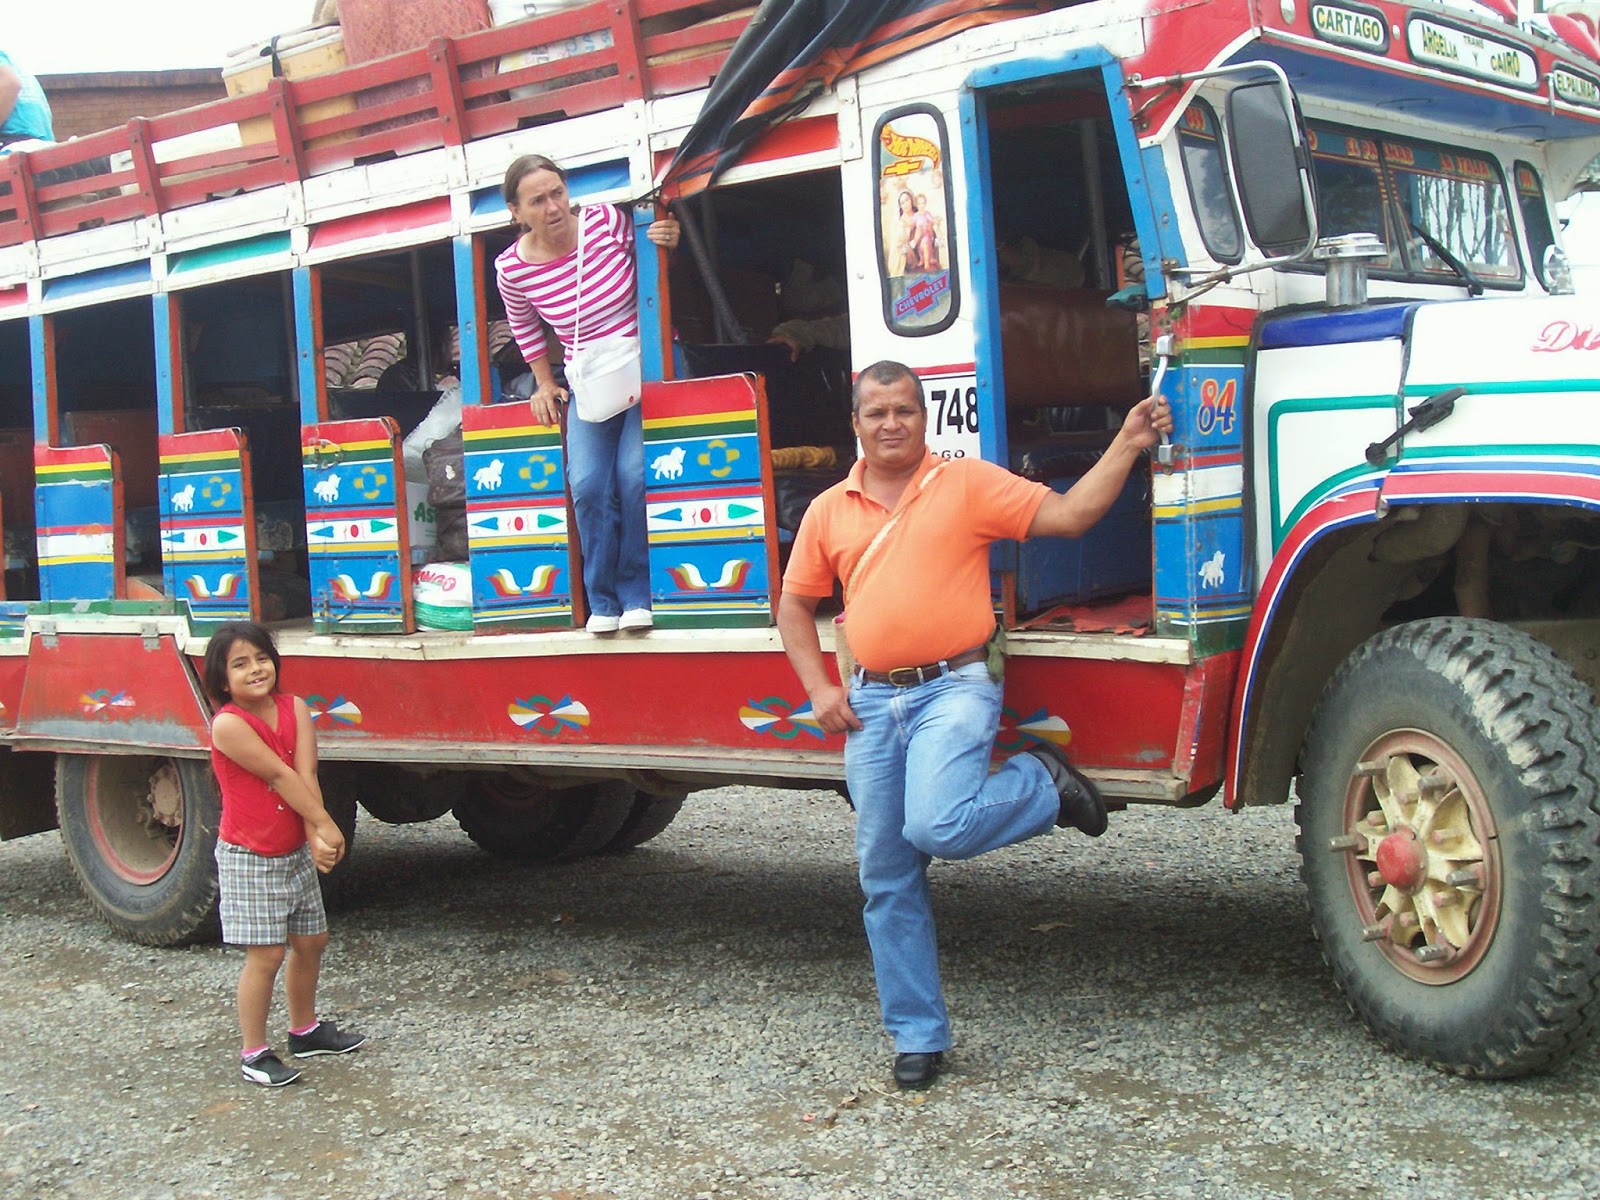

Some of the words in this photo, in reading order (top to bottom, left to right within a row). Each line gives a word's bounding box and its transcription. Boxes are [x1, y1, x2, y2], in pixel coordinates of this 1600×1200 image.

[1316, 7, 1380, 41] CARTAGO
[1421, 23, 1458, 61] ARGELIA
[1490, 51, 1520, 78] CAIRO
[898, 279, 944, 312] CHEVROLET
[931, 387, 979, 435] 748
[1197, 378, 1236, 435] 84
